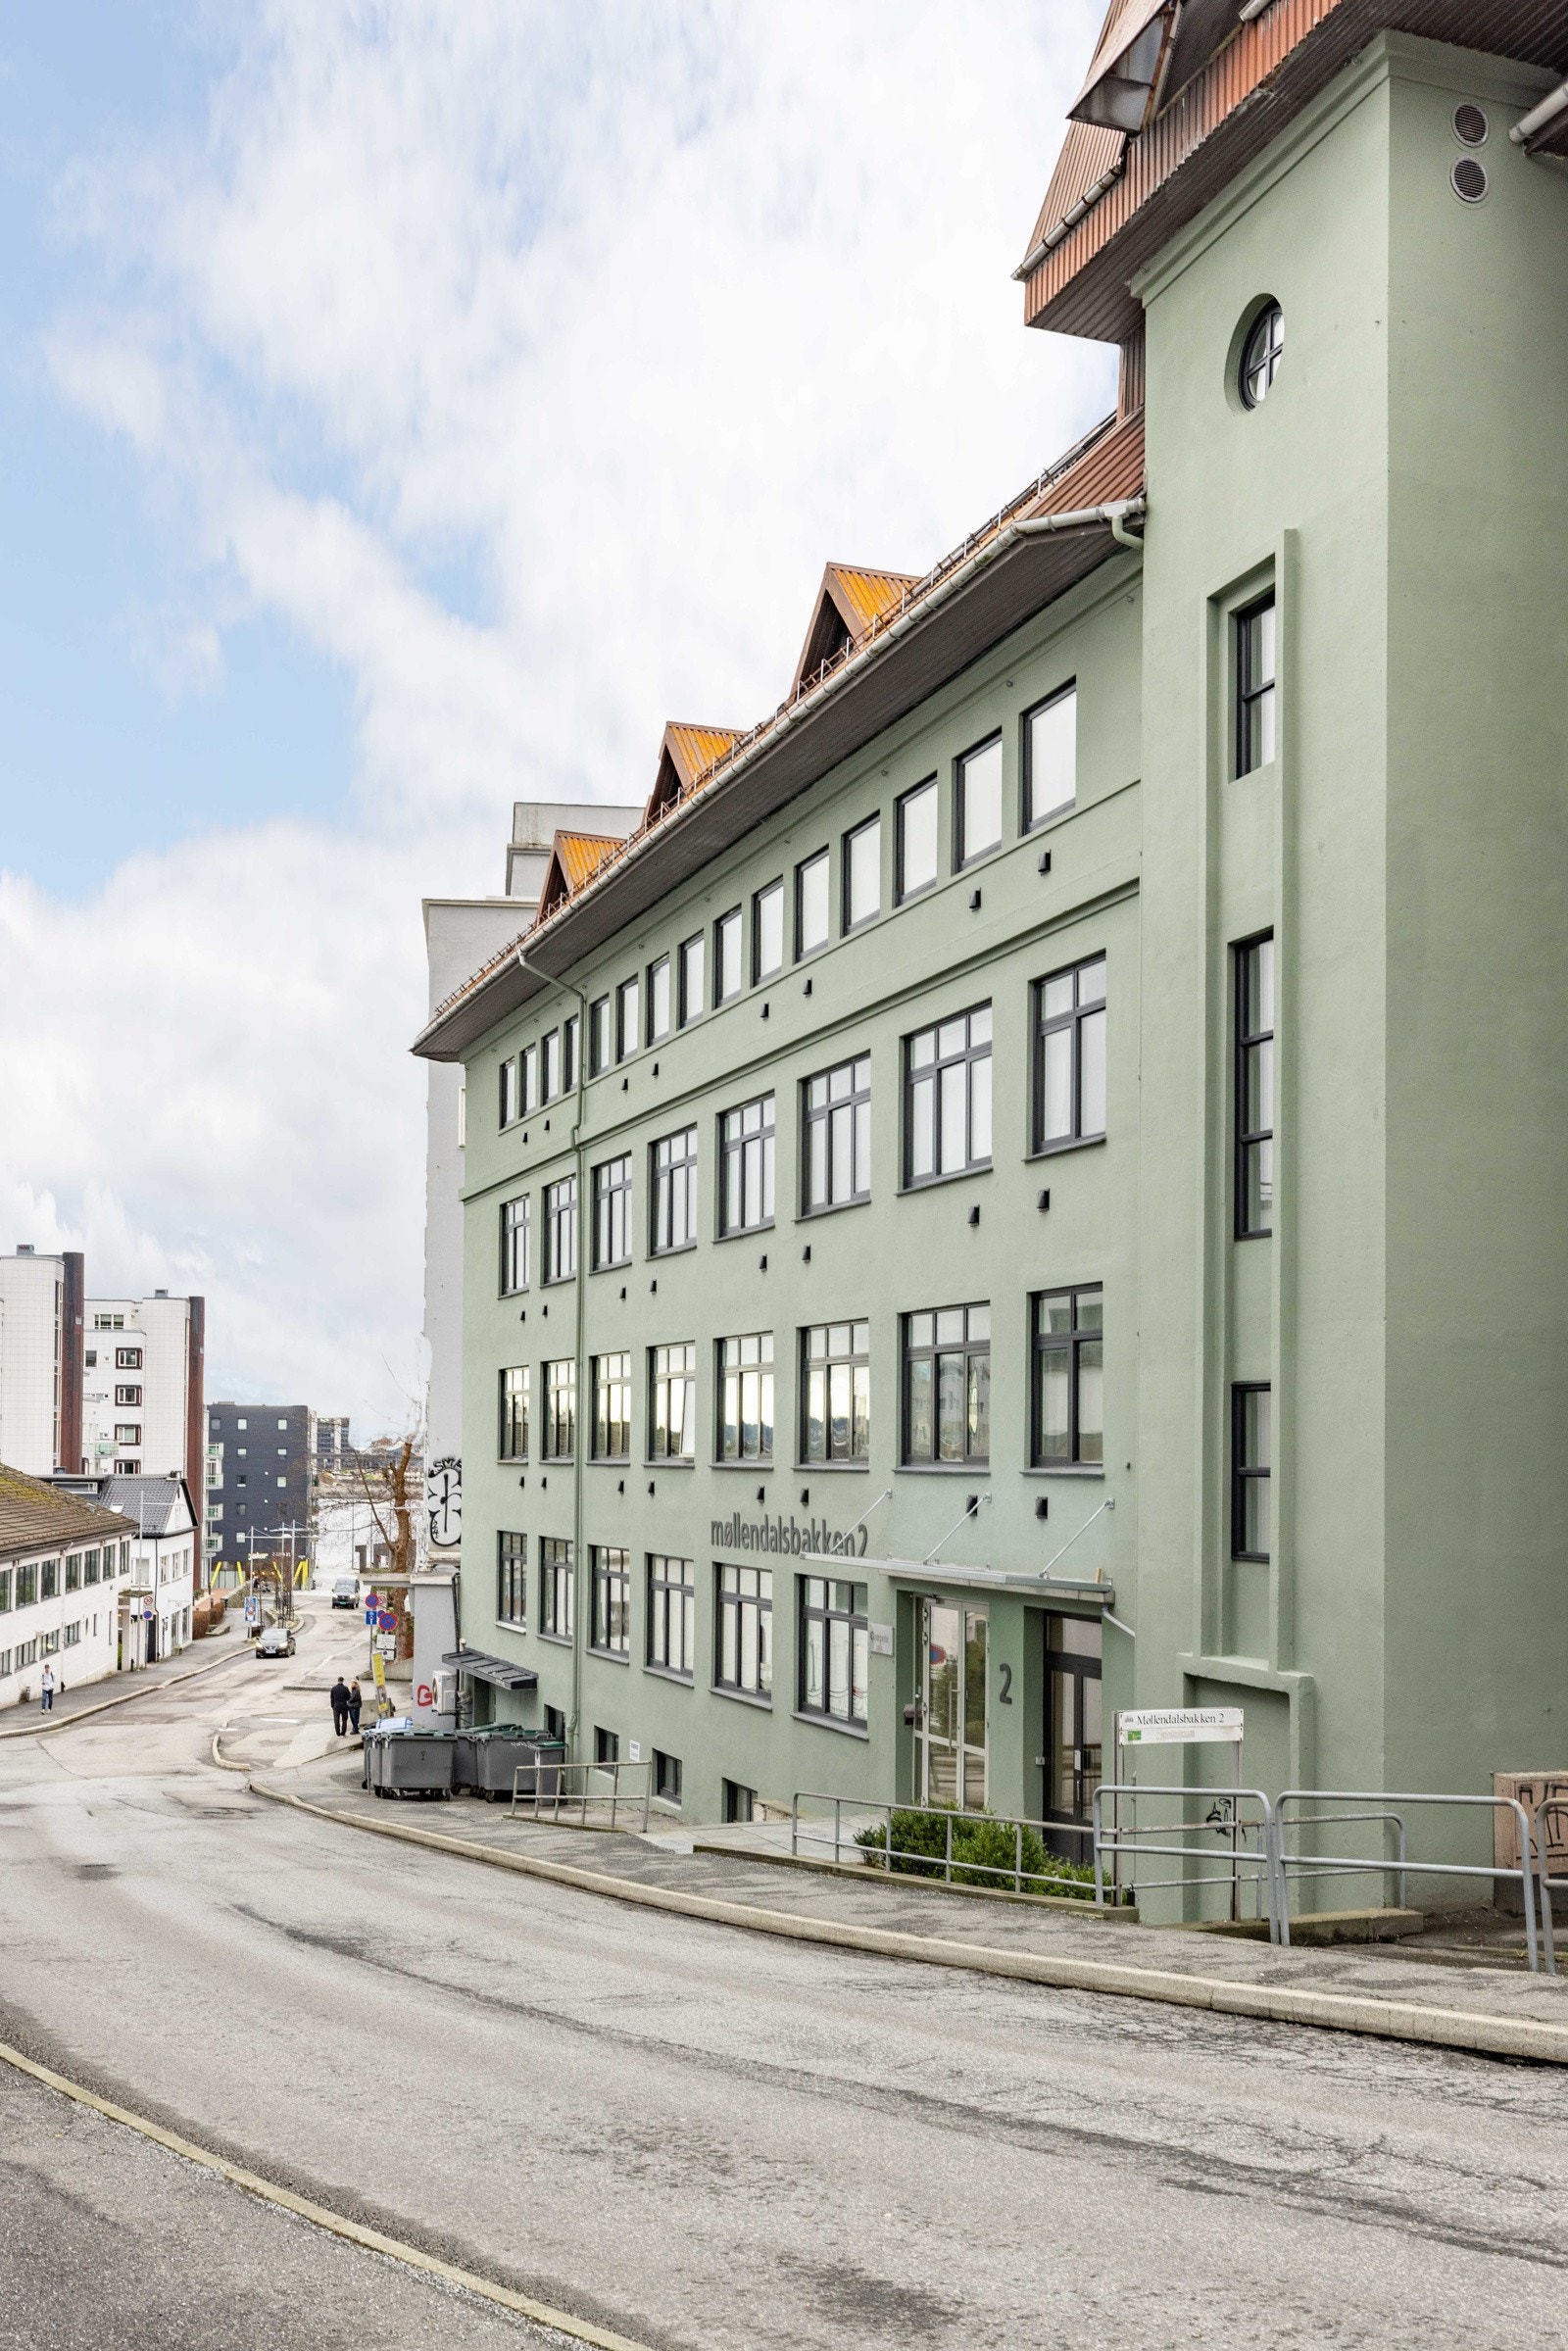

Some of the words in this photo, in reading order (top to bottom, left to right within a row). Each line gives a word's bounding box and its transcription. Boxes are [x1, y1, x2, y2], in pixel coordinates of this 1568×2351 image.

[710, 1512, 855, 1557] møllendalsbakken
[858, 1524, 868, 1557] 2
[1000, 1663, 1012, 1704] 2
[1218, 1713, 1225, 1723] 2
